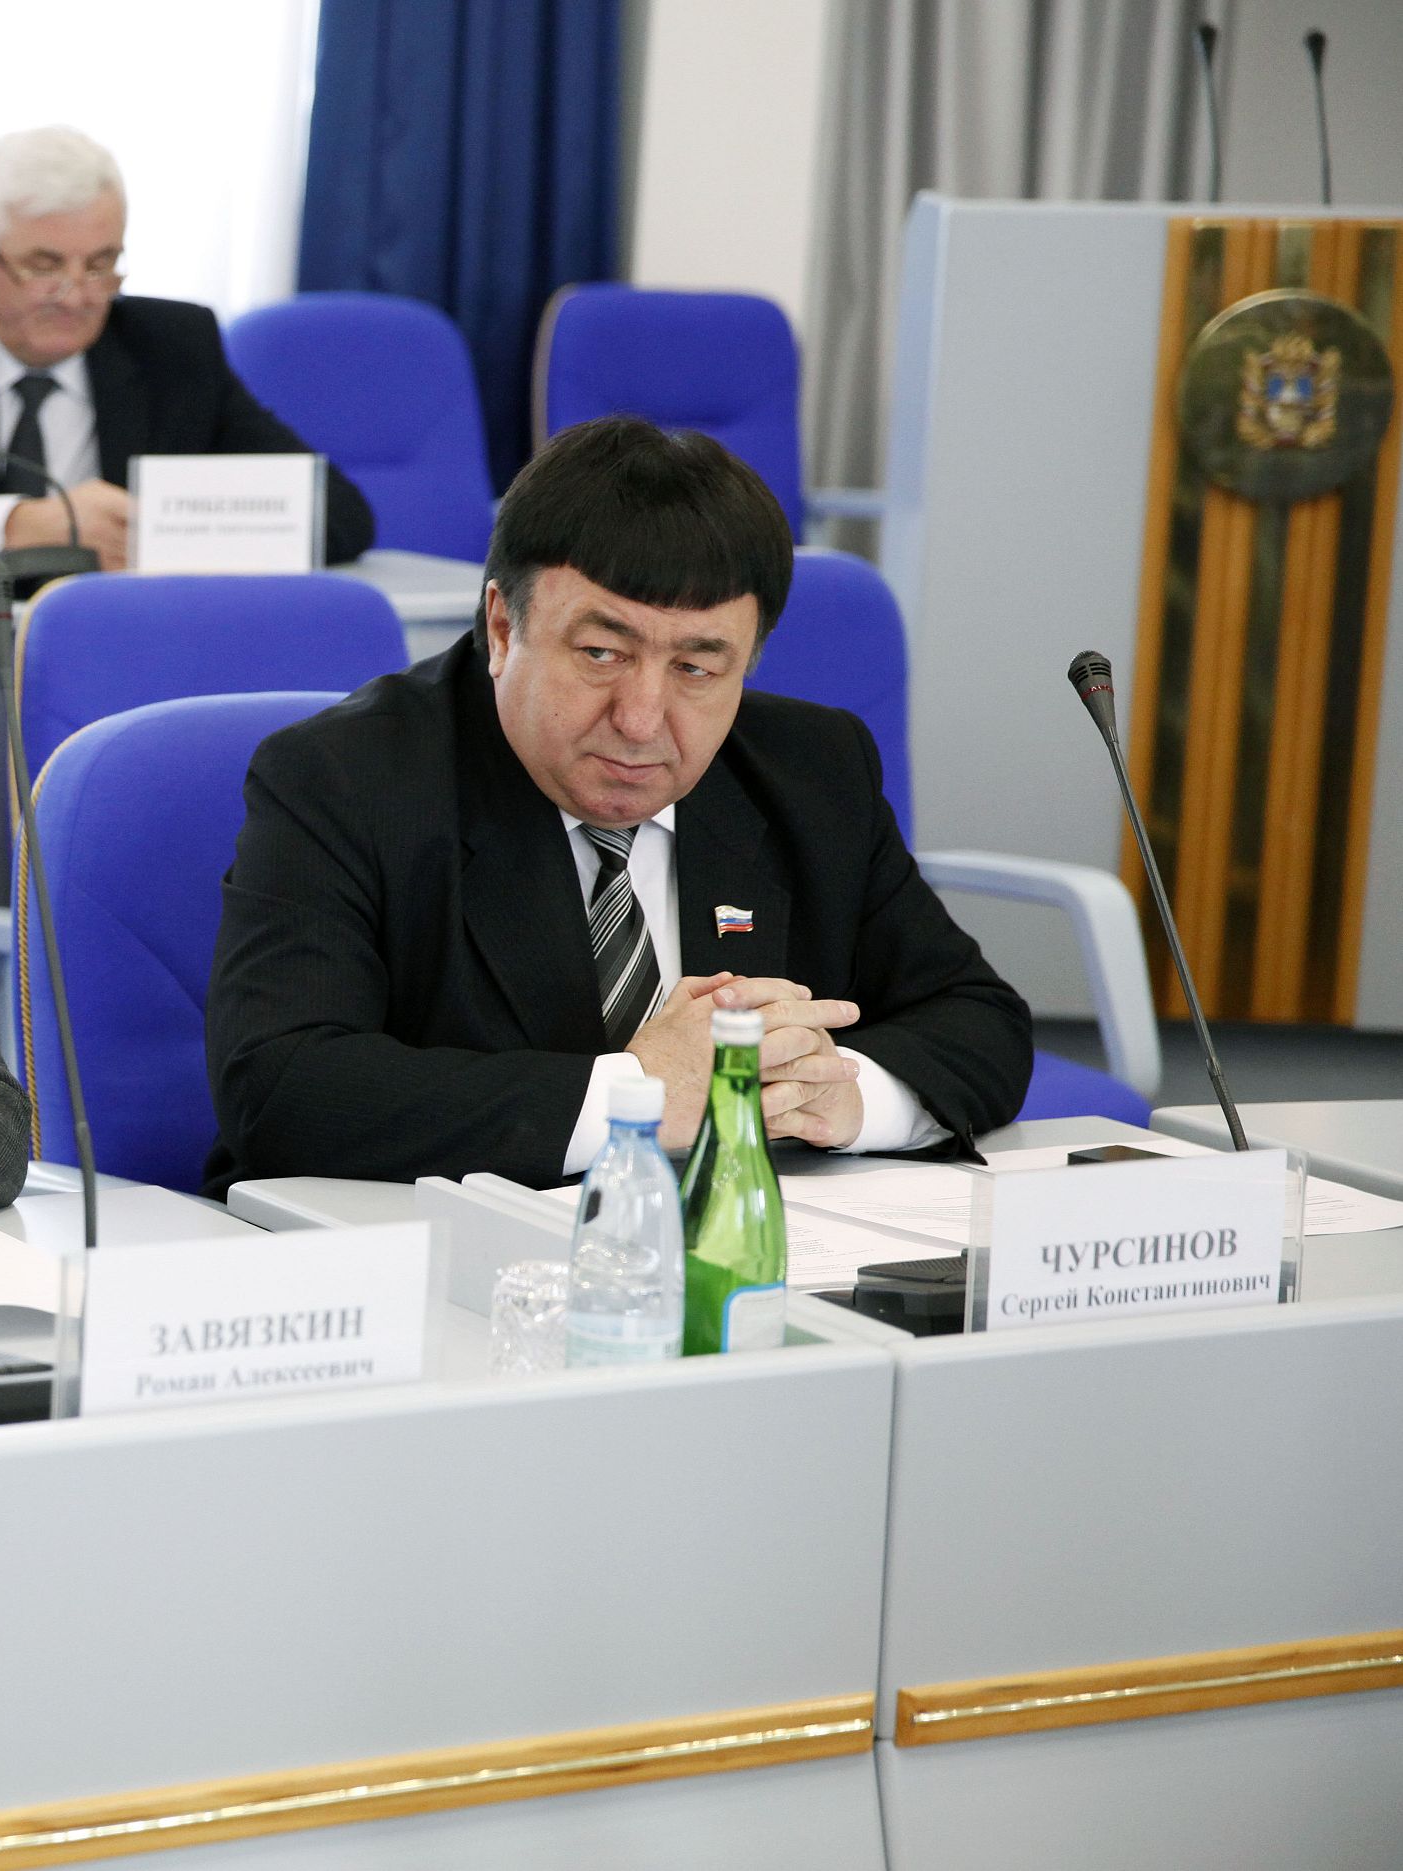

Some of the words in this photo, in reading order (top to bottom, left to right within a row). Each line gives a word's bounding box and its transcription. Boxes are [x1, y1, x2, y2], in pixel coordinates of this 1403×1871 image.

[1041, 1228, 1238, 1273] ЧУРСИНОВ
[1001, 1288, 1078, 1319] Сергей
[1088, 1274, 1271, 1307] Константинович
[150, 1306, 365, 1357] ЗАВЯЗКИН
[137, 1372, 216, 1397] Роман
[225, 1358, 374, 1389] Алексеевич
